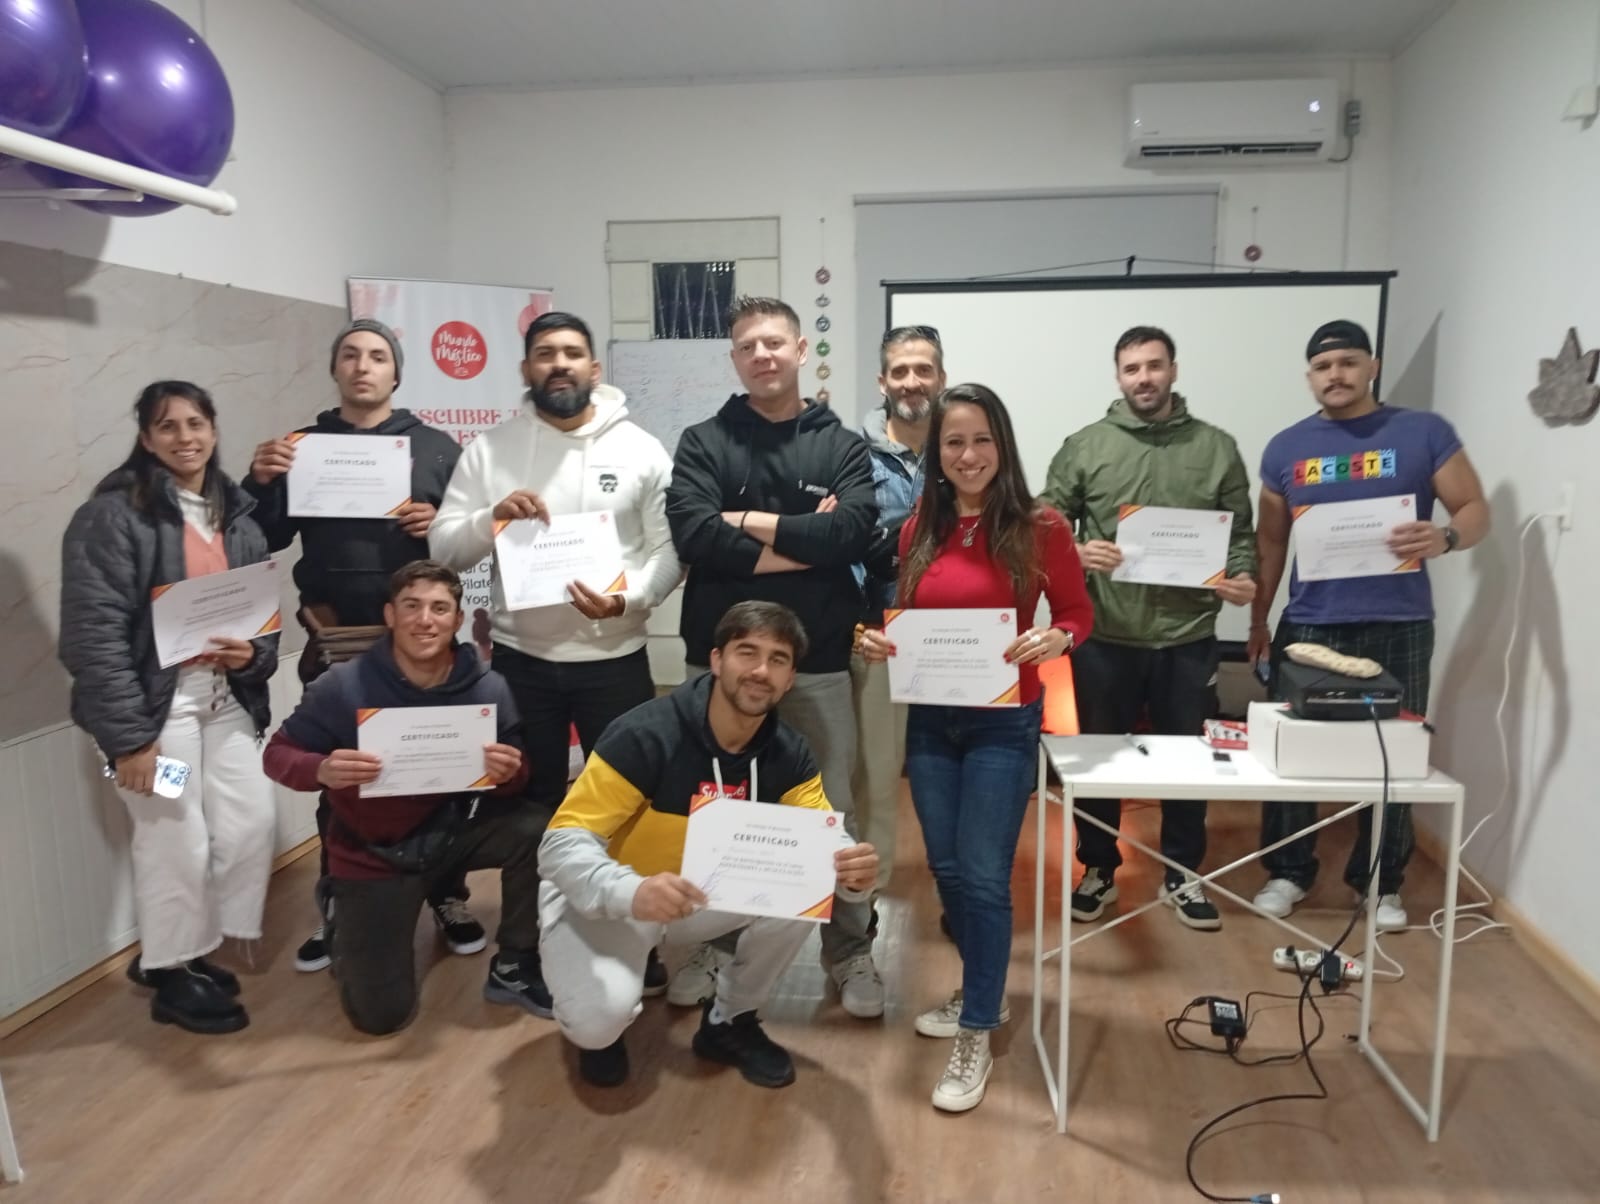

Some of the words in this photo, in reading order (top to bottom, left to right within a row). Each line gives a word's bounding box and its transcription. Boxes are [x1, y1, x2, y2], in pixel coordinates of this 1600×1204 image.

[438, 331, 477, 346] Mundo
[412, 408, 502, 425] SCUBRE
[1294, 456, 1392, 479] LACOSTE
[533, 538, 585, 550] CERTIFICADO
[465, 595, 489, 607] Yog
[923, 637, 980, 645] CERTIFICADO
[401, 732, 460, 741] CERTIFICADO
[733, 833, 799, 848] CERTIFICADO
